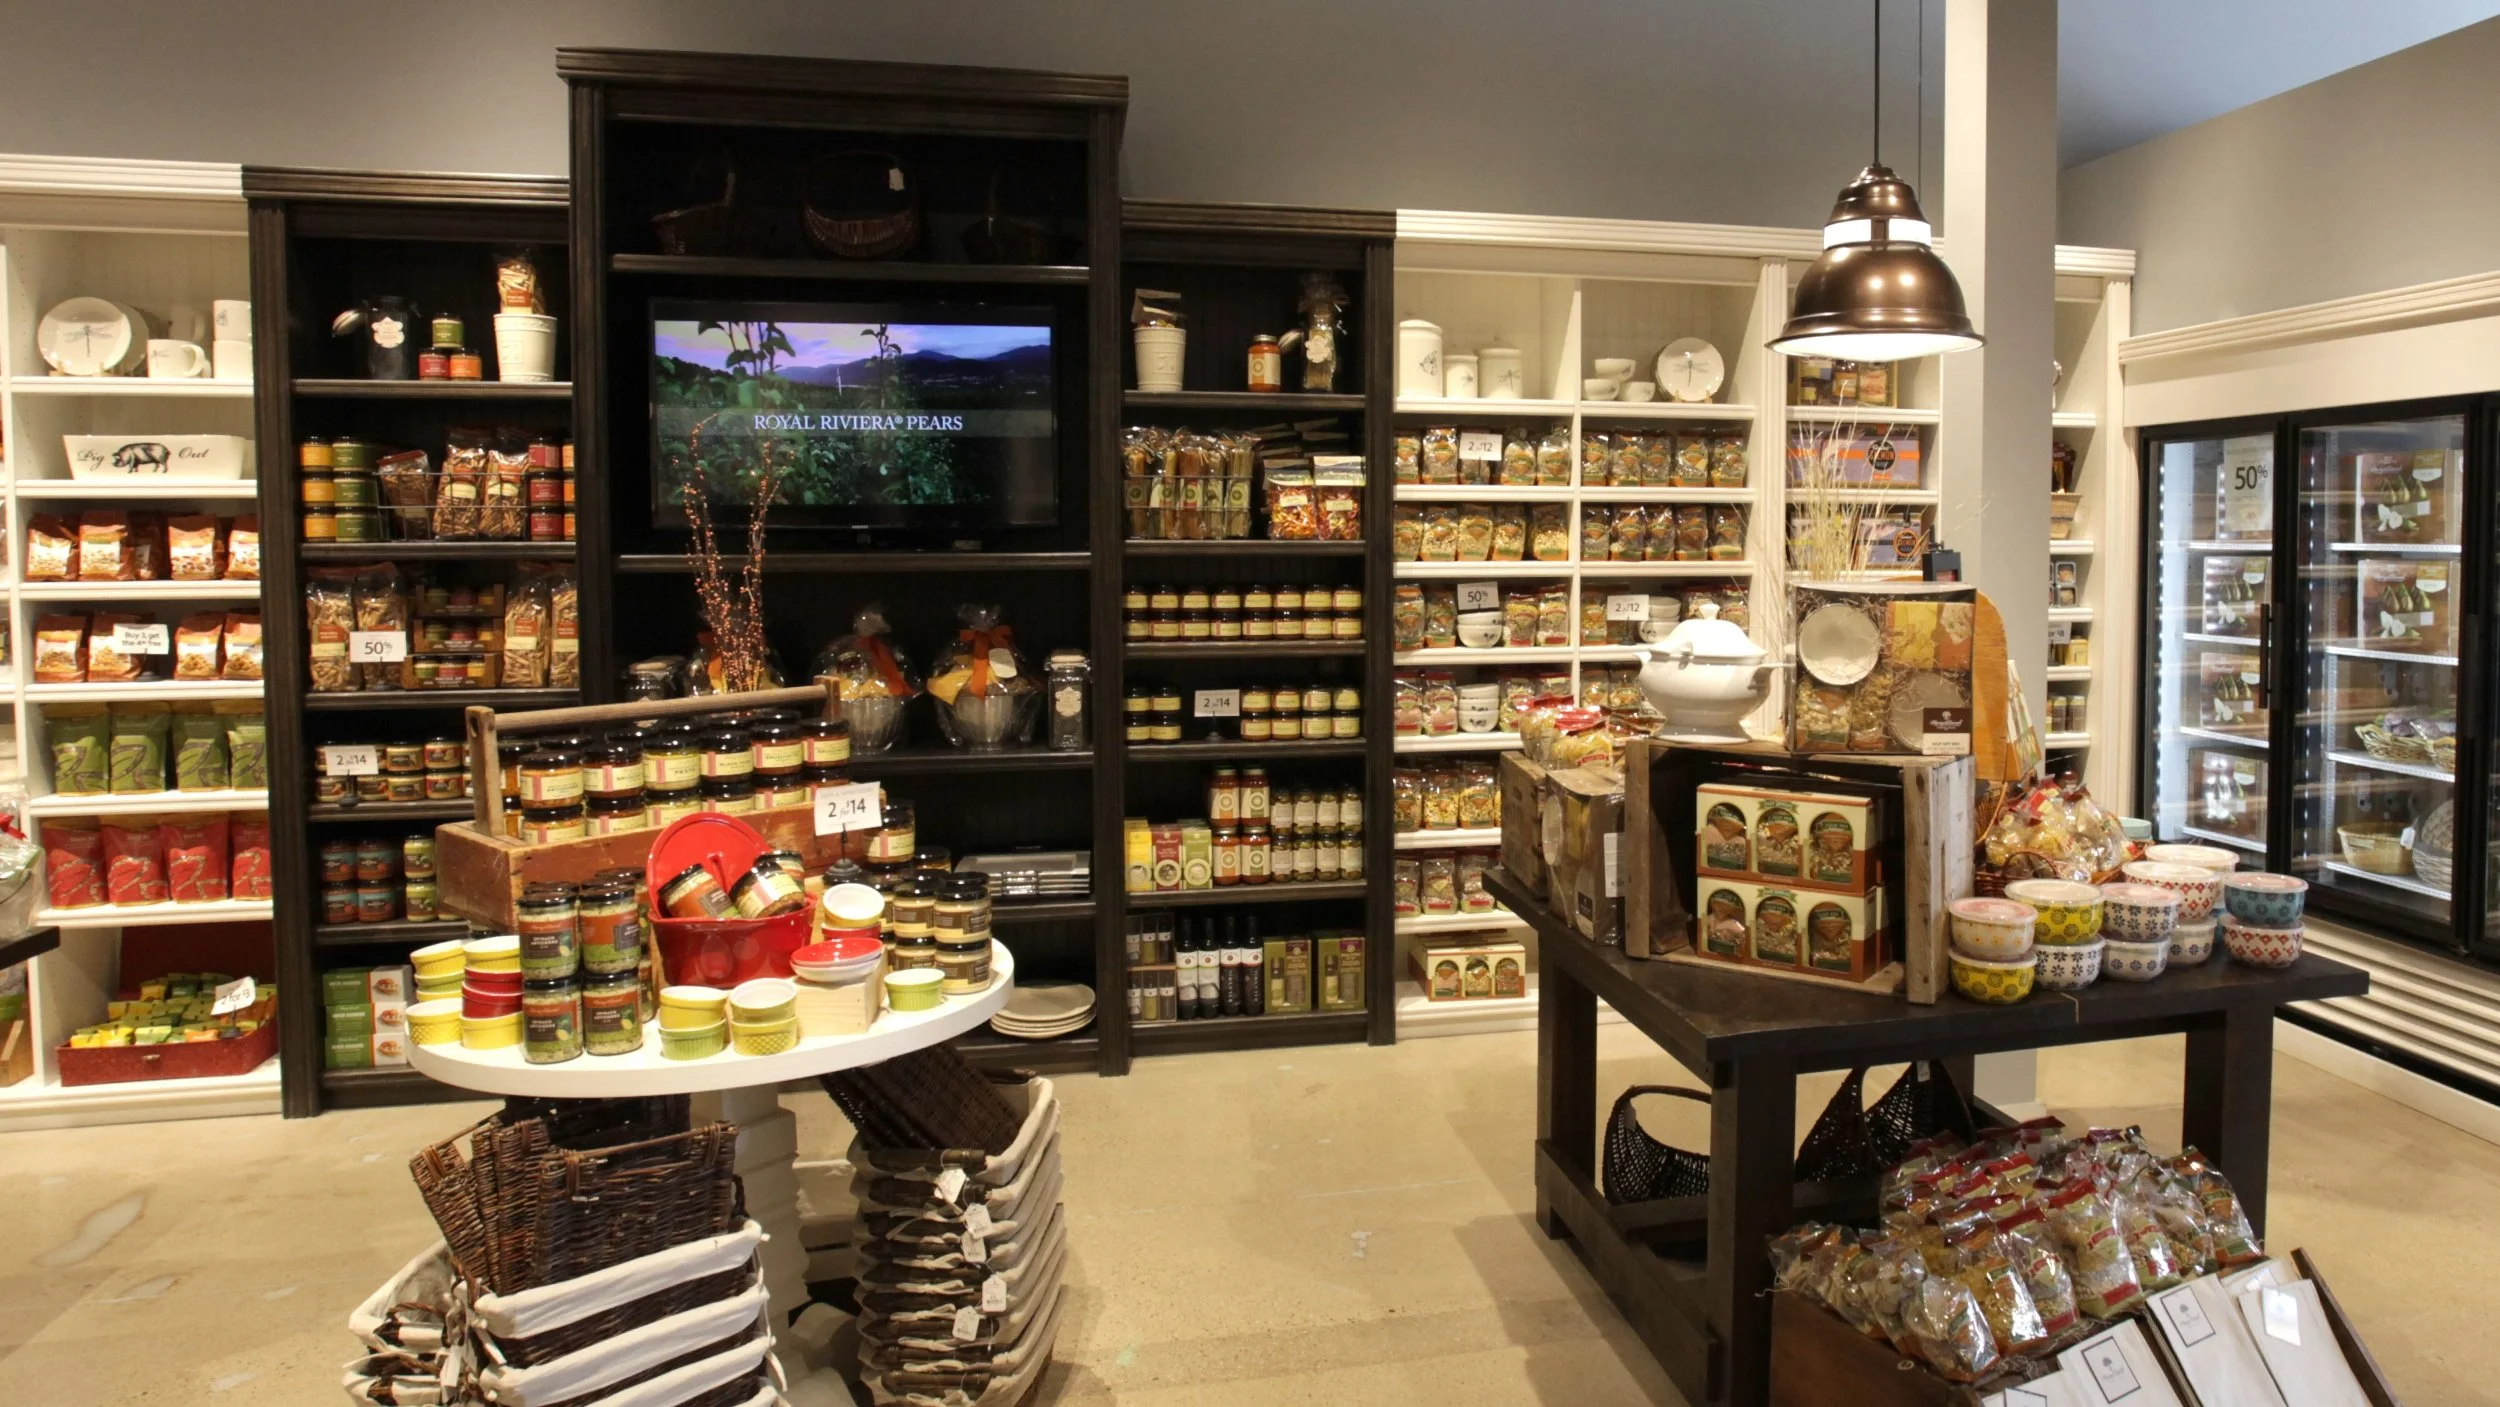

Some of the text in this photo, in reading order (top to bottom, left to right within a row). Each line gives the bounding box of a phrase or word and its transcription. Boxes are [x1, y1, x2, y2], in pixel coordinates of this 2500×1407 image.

[753, 415, 815, 430] ROYAL
[907, 415, 963, 431] PEARS
[1468, 441, 1475, 451] 2
[77, 446, 210, 471] Pig Out
[2234, 464, 2269, 490] 50%
[1467, 590, 1489, 603] 50%
[1615, 602, 1622, 612] 2
[124, 631, 140, 640] Buy
[147, 633, 160, 641] get
[364, 641, 393, 655] 50%
[1203, 697, 1210, 708] 2
[335, 754, 345, 766] 2
[827, 802, 837, 818] 2
[846, 798, 866, 814] $14
[229, 992, 241, 1003] for
